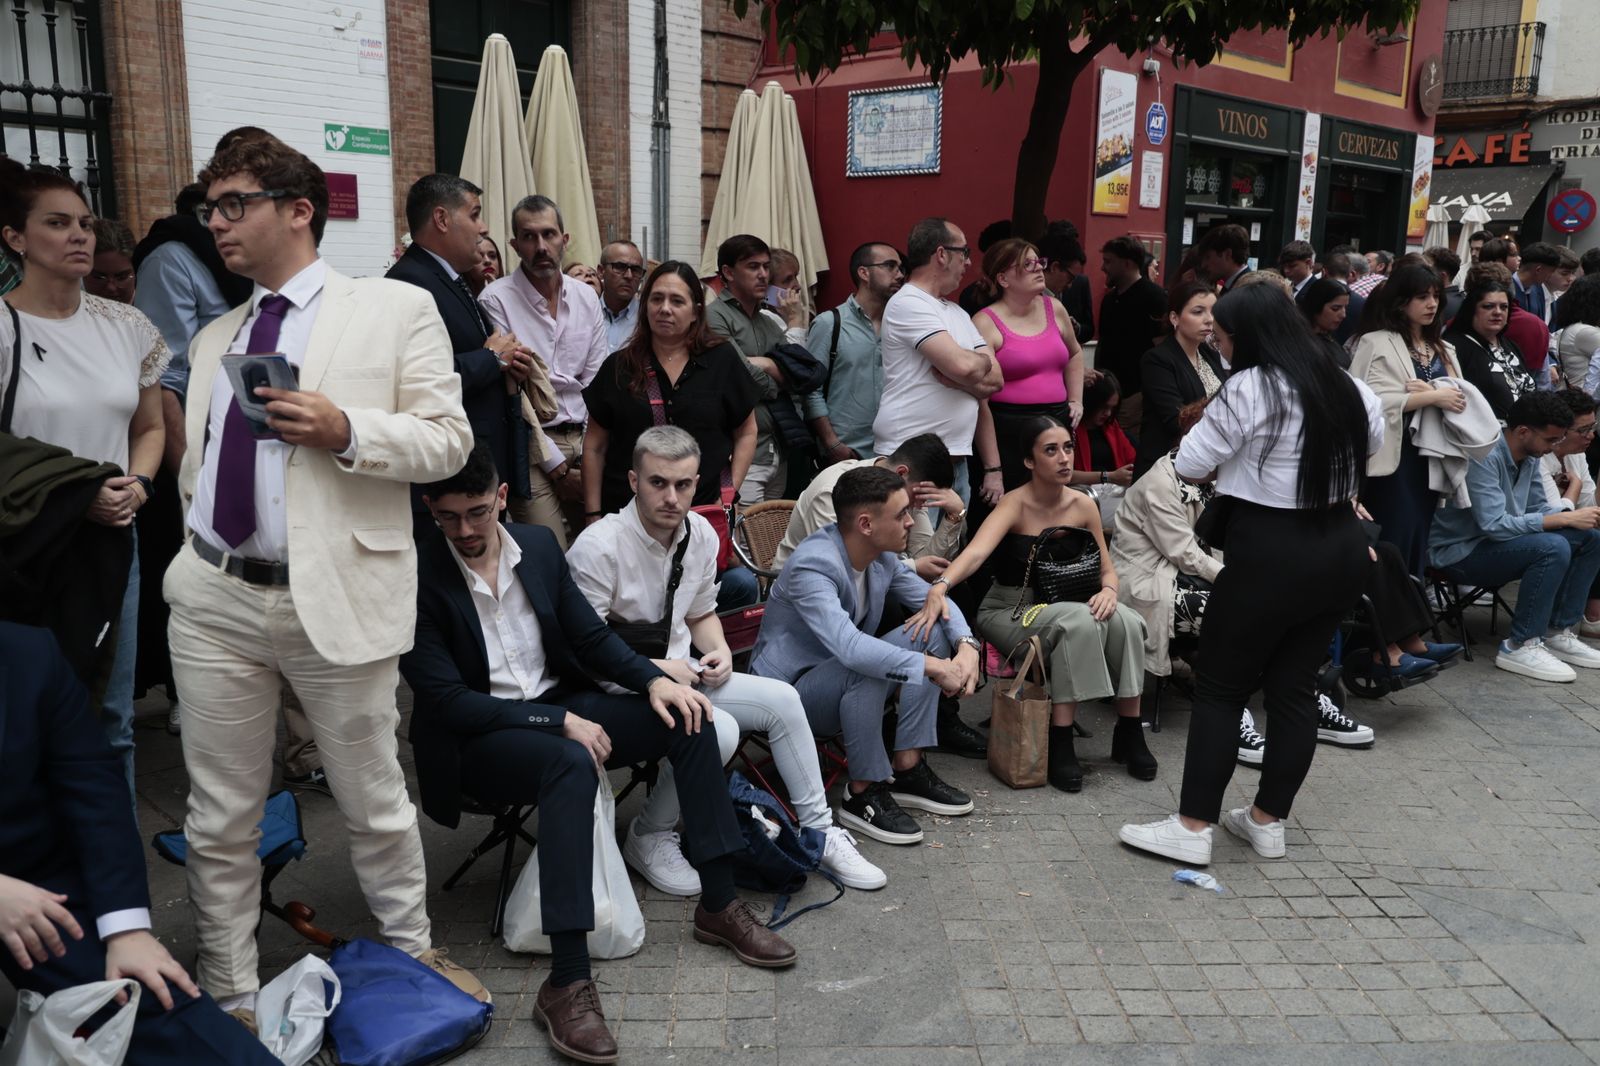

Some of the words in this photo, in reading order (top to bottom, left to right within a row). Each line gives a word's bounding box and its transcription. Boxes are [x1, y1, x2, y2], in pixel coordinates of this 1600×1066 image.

[1150, 115, 1164, 129] ADT
[1217, 108, 1268, 139] VINOS
[1338, 131, 1399, 160] CERVEZAS
[1108, 182, 1128, 196] 13,95€
